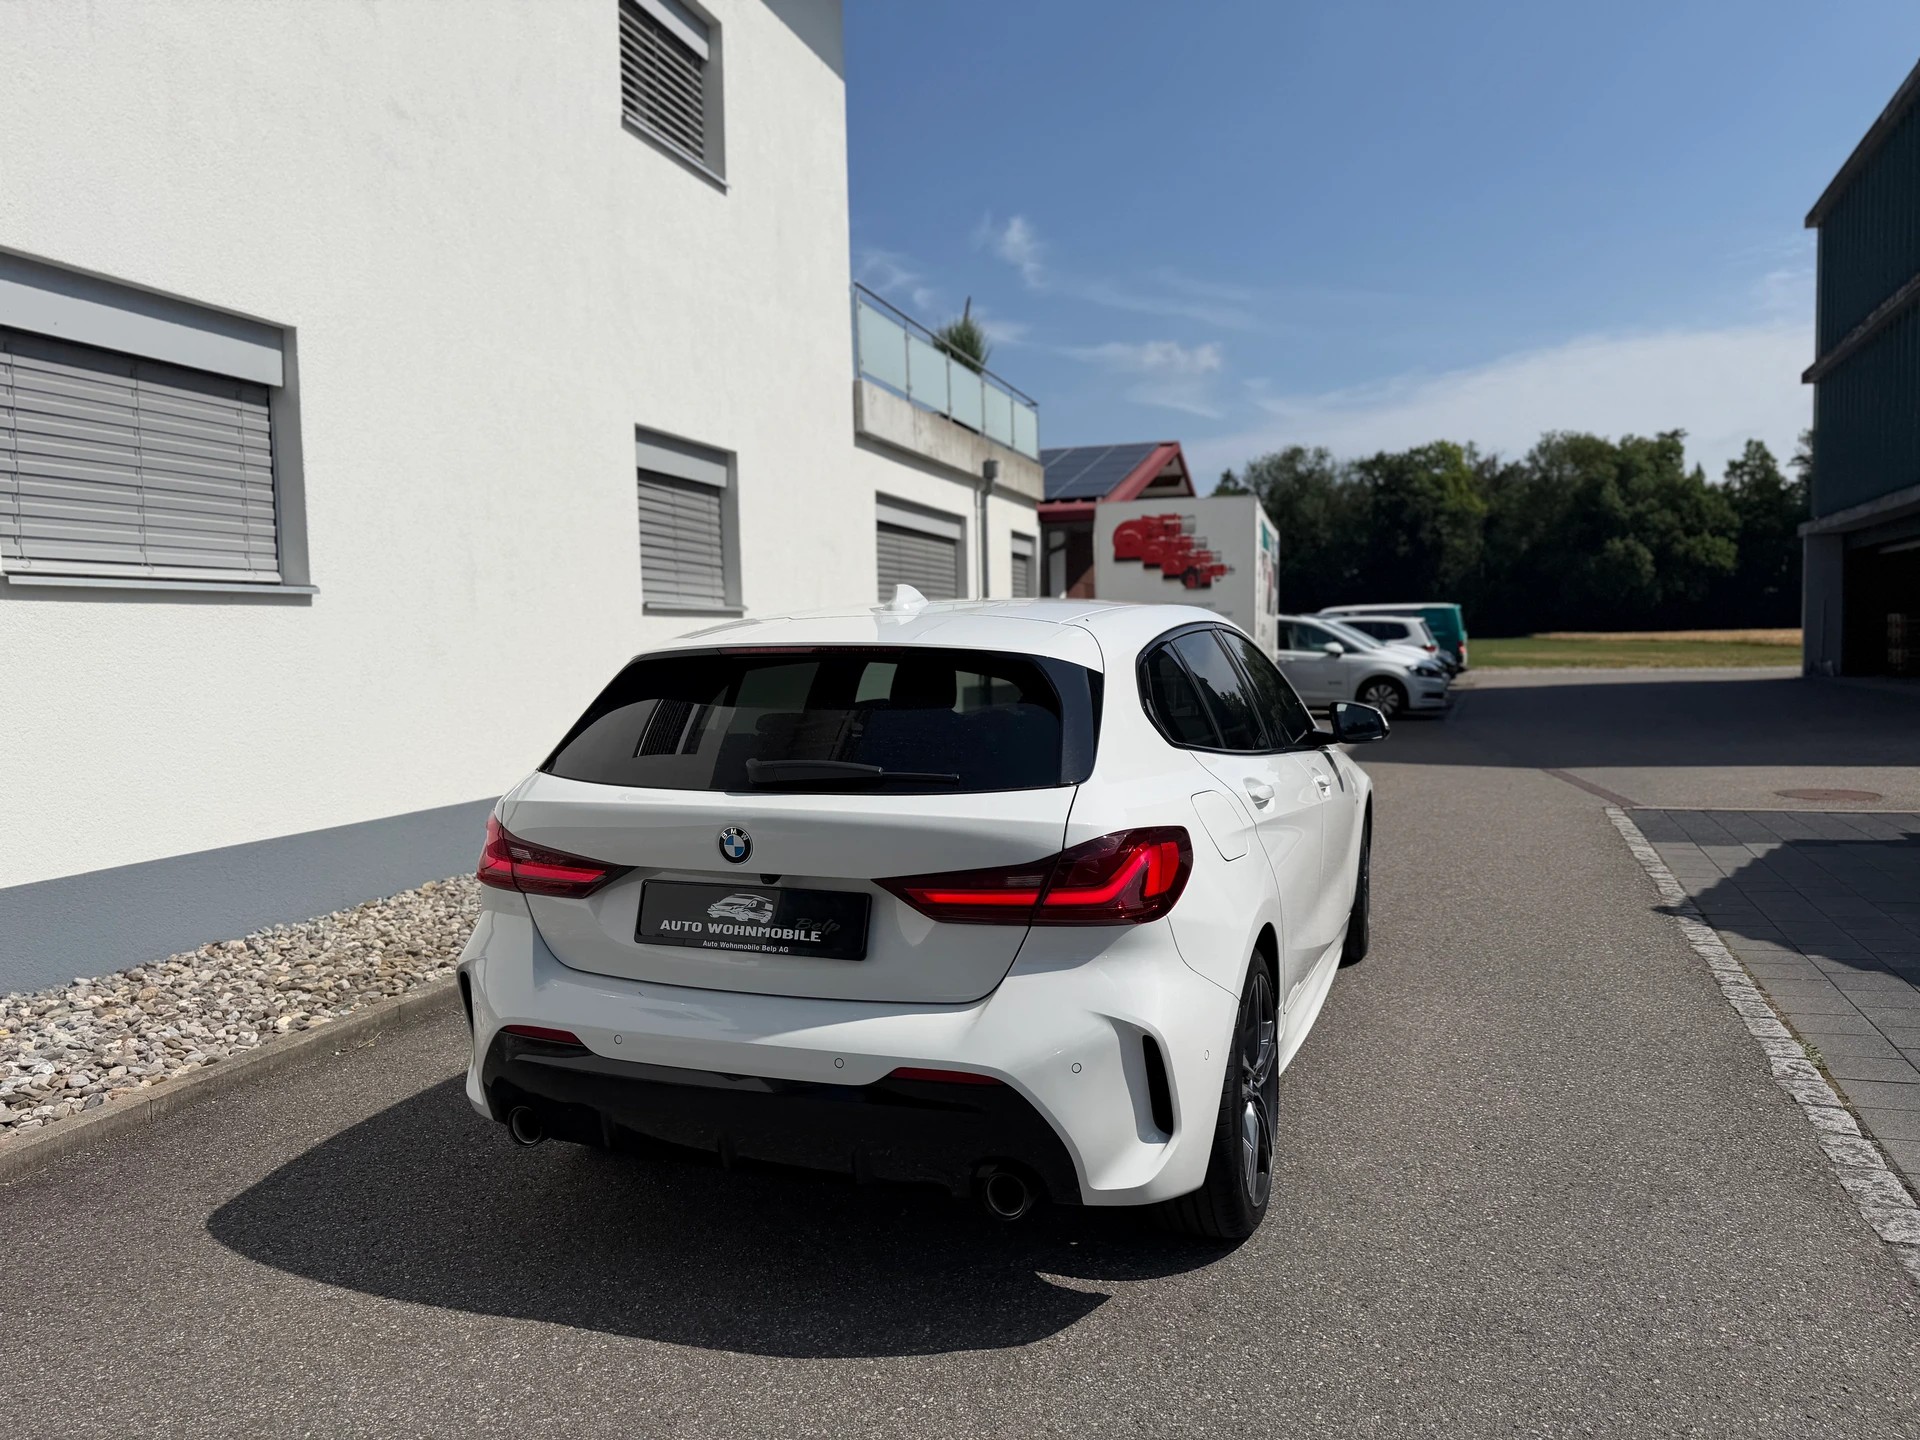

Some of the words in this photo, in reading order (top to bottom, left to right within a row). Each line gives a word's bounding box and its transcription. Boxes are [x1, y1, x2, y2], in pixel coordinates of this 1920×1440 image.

[721, 828, 749, 840] BMW
[660, 919, 702, 932] AUTO
[708, 923, 821, 942] WOHNMOBILE
[794, 917, 841, 935] Belp
[703, 940, 718, 948] Auto
[719, 942, 760, 950] Wohnmobile
[762, 944, 777, 952] Belp
